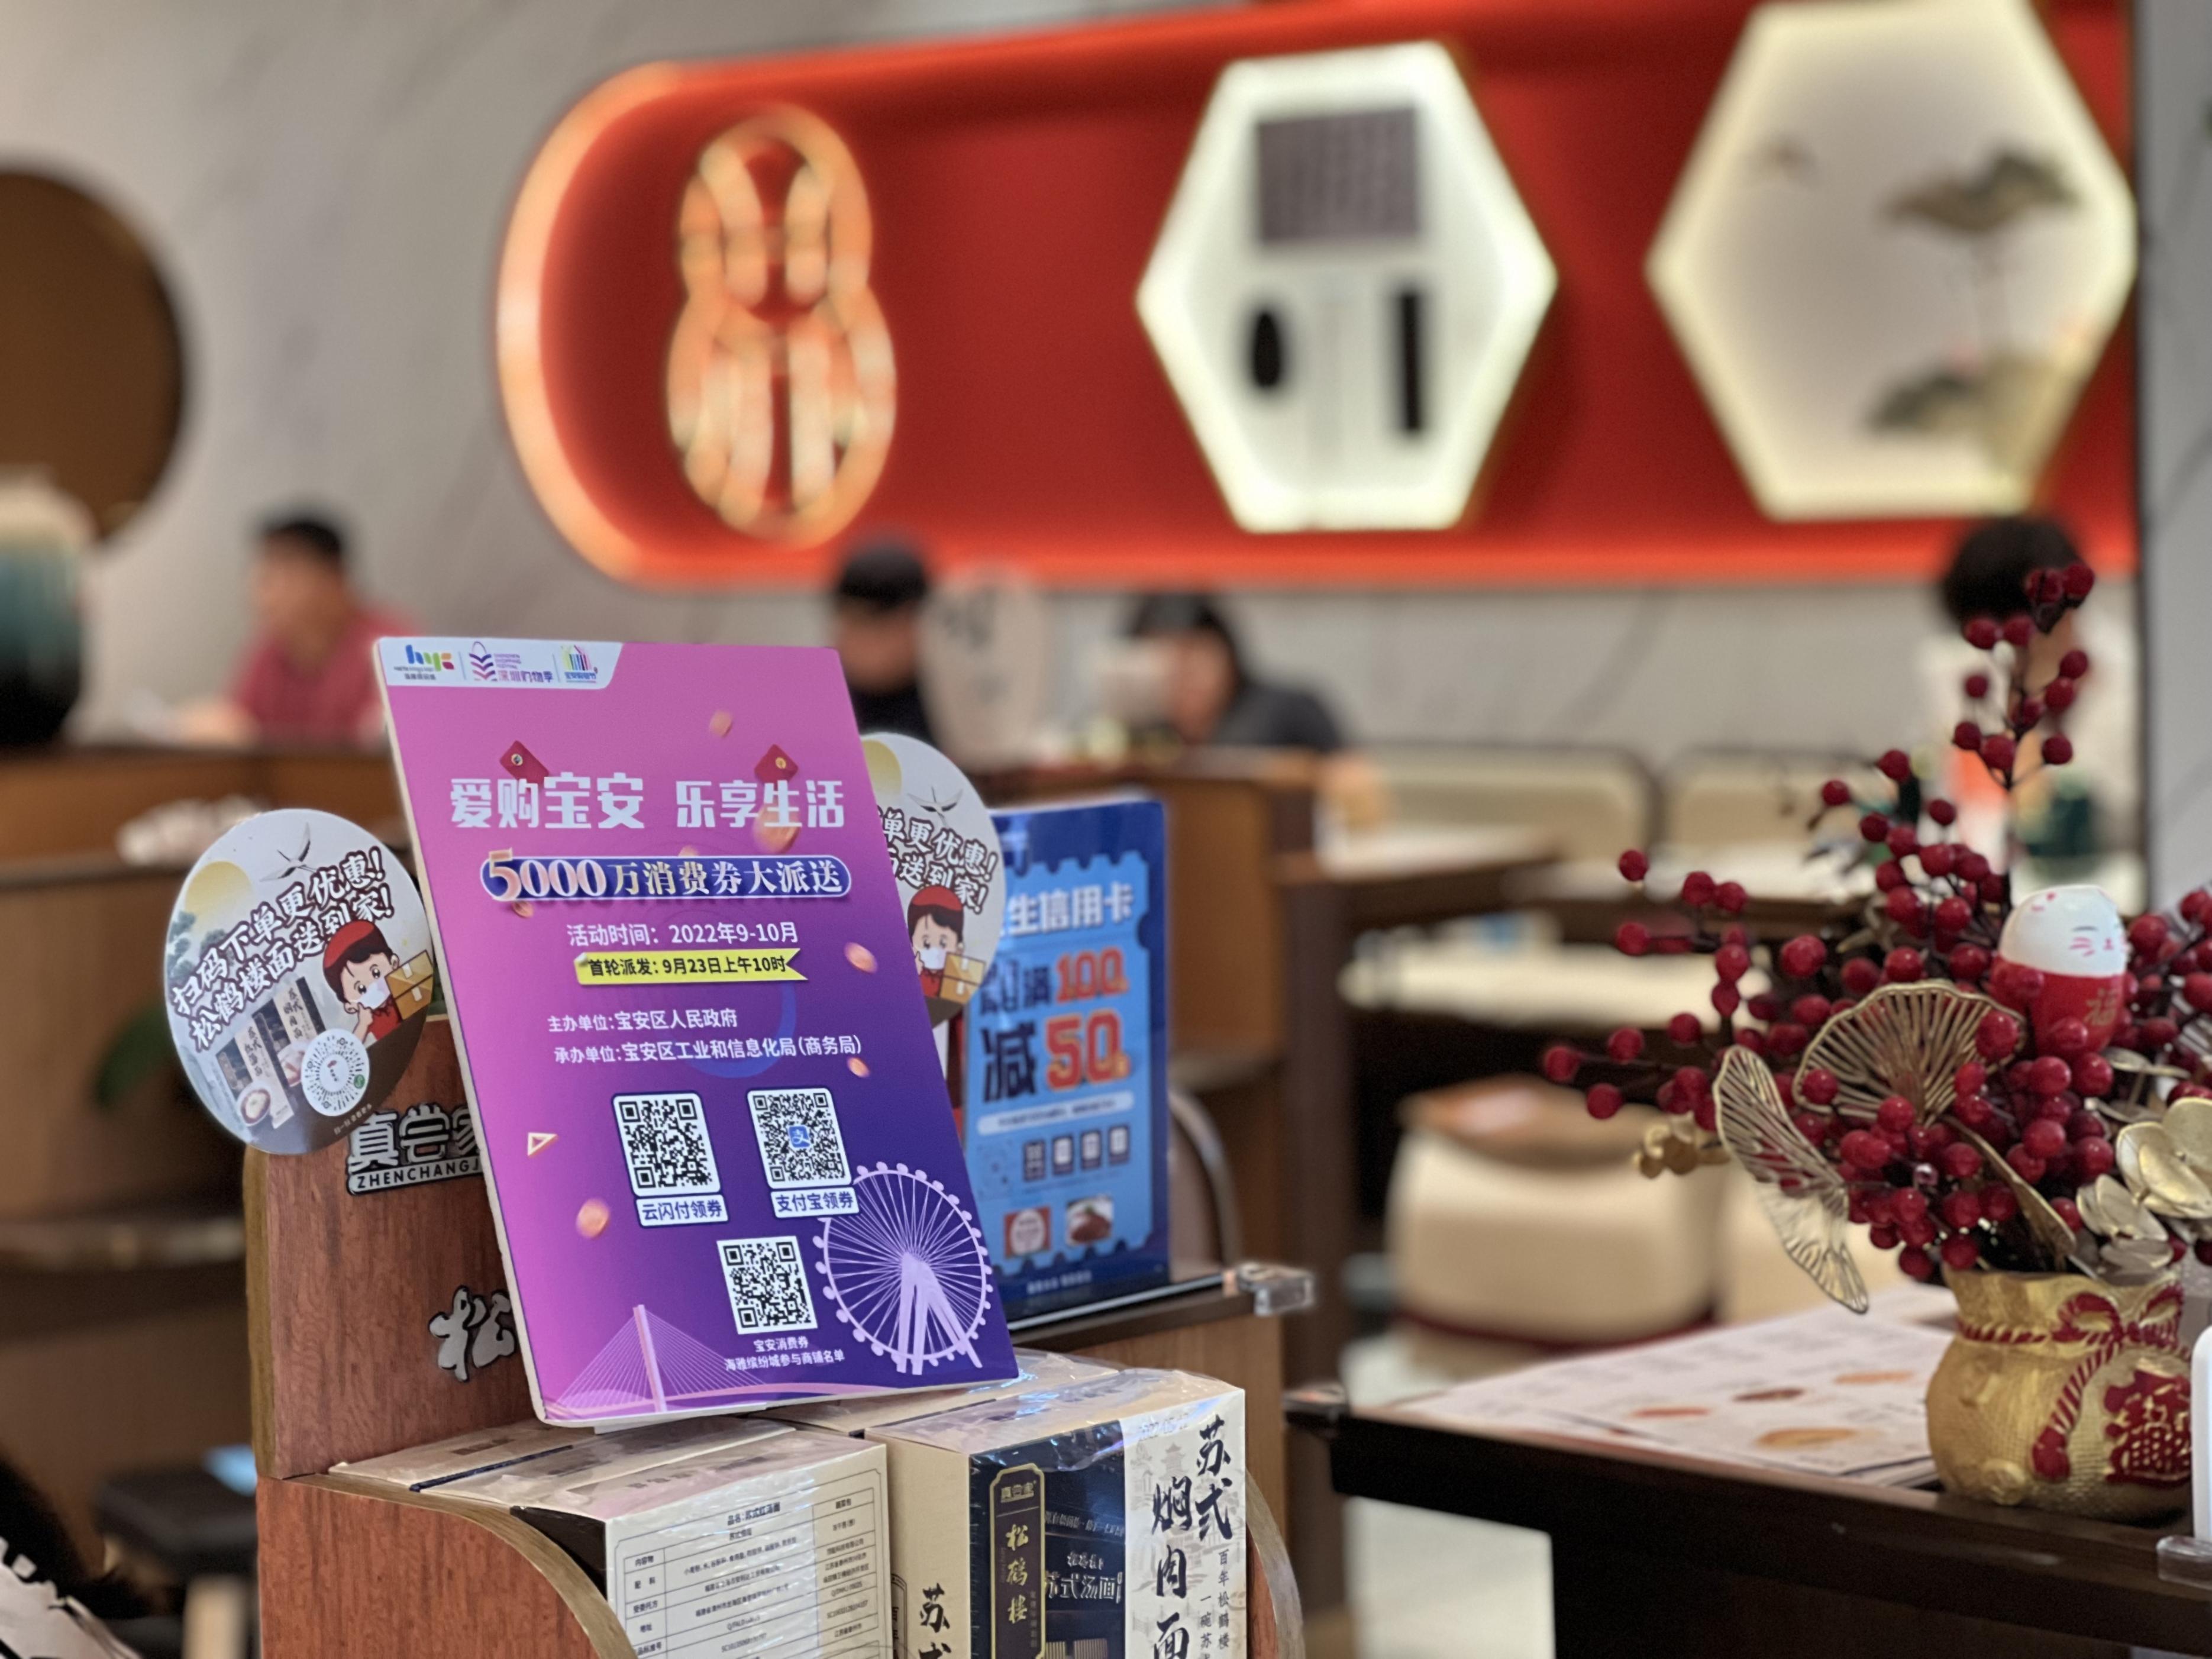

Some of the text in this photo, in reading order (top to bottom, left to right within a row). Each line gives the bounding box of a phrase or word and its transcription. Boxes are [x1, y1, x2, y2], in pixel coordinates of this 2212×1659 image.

[450, 772, 845, 828] 爱购宝安 乐享生活
[878, 807, 998, 882] 单更优惠!
[488, 848, 842, 900] 5000万消费券大派送
[887, 846, 989, 914] 送到家!
[1000, 880, 1134, 937] 生信用卡
[547, 1008, 739, 1033] 主办单位:宝安区人民政府
[357, 1158, 479, 1189] ZHENCHANGJ
[776, 1190, 854, 1213] 支付宝领券
[641, 1199, 723, 1222] 云闪付领券
[753, 1336, 809, 1353] 宝安消费券
[1196, 1413, 1233, 1541] 苏式
[1005, 1524, 1029, 1624] 松鹤楼
[1217, 1548, 1231, 1650] 百年松鹤楼
